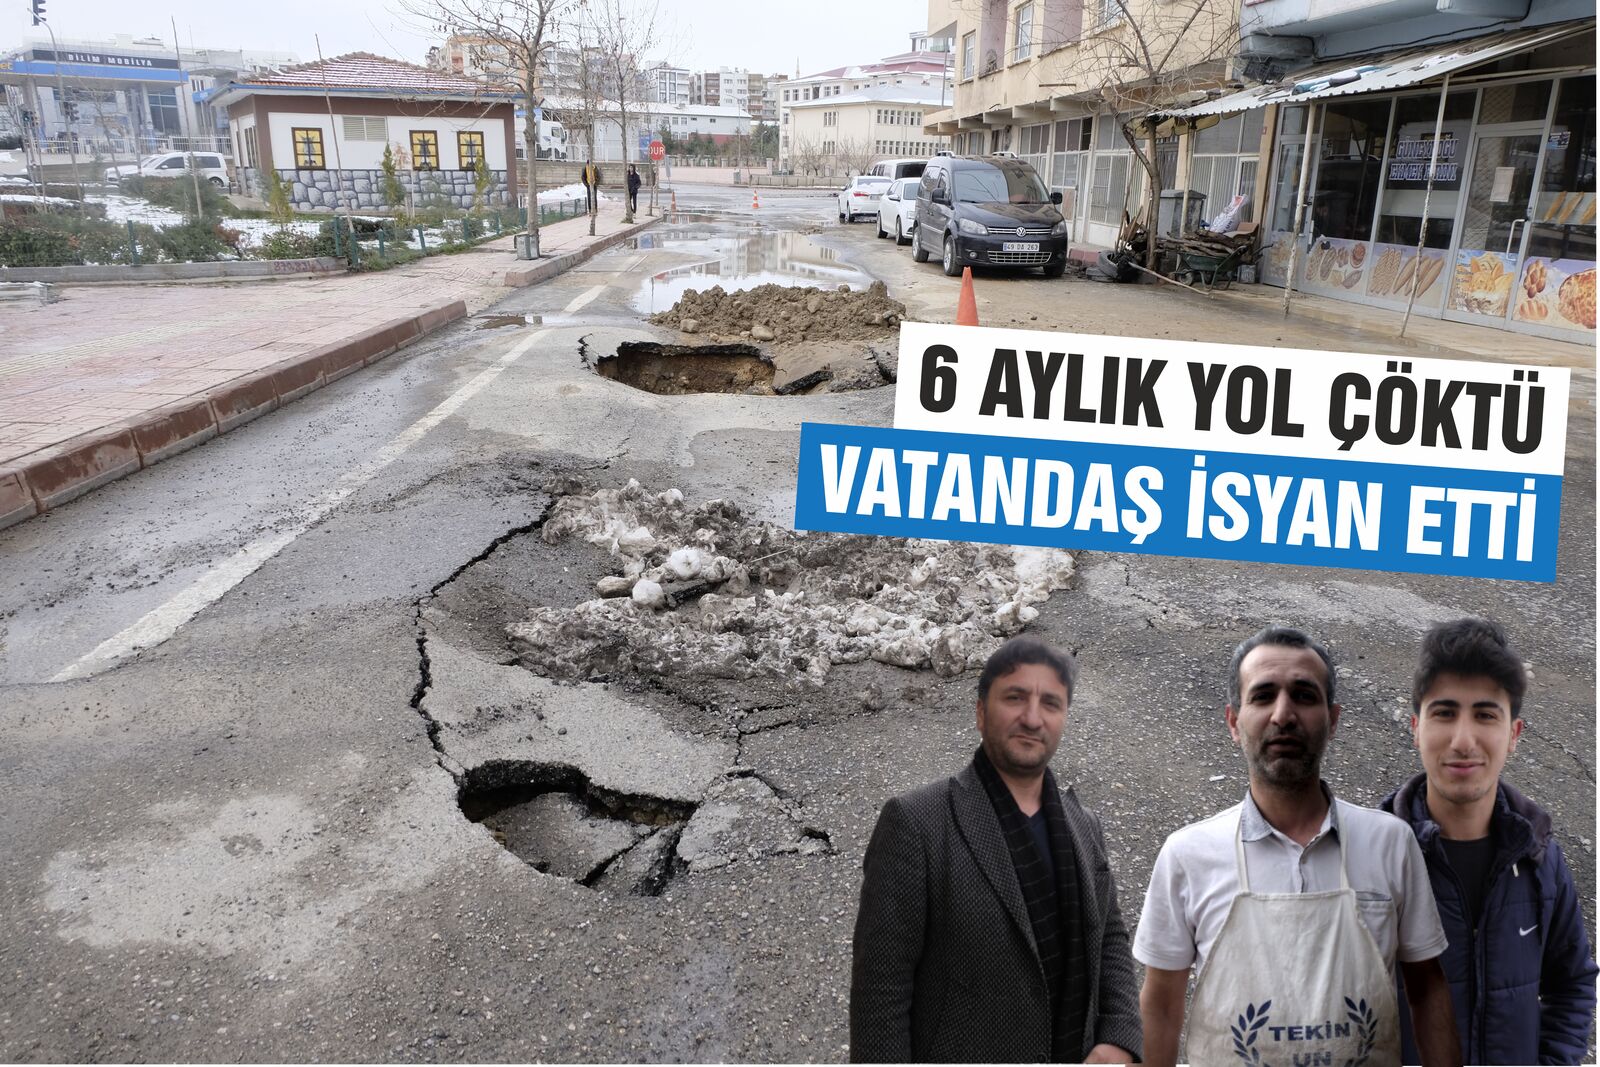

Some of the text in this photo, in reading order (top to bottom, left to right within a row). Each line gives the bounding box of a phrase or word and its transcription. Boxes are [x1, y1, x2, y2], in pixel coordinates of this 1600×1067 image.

[68, 53, 153, 67] BİLİM MOBİLYA
[1396, 135, 1459, 159] GÜNEYOĞU
[1268, 1020, 1351, 1042] TEKİN
[1292, 1051, 1332, 1067] UN
